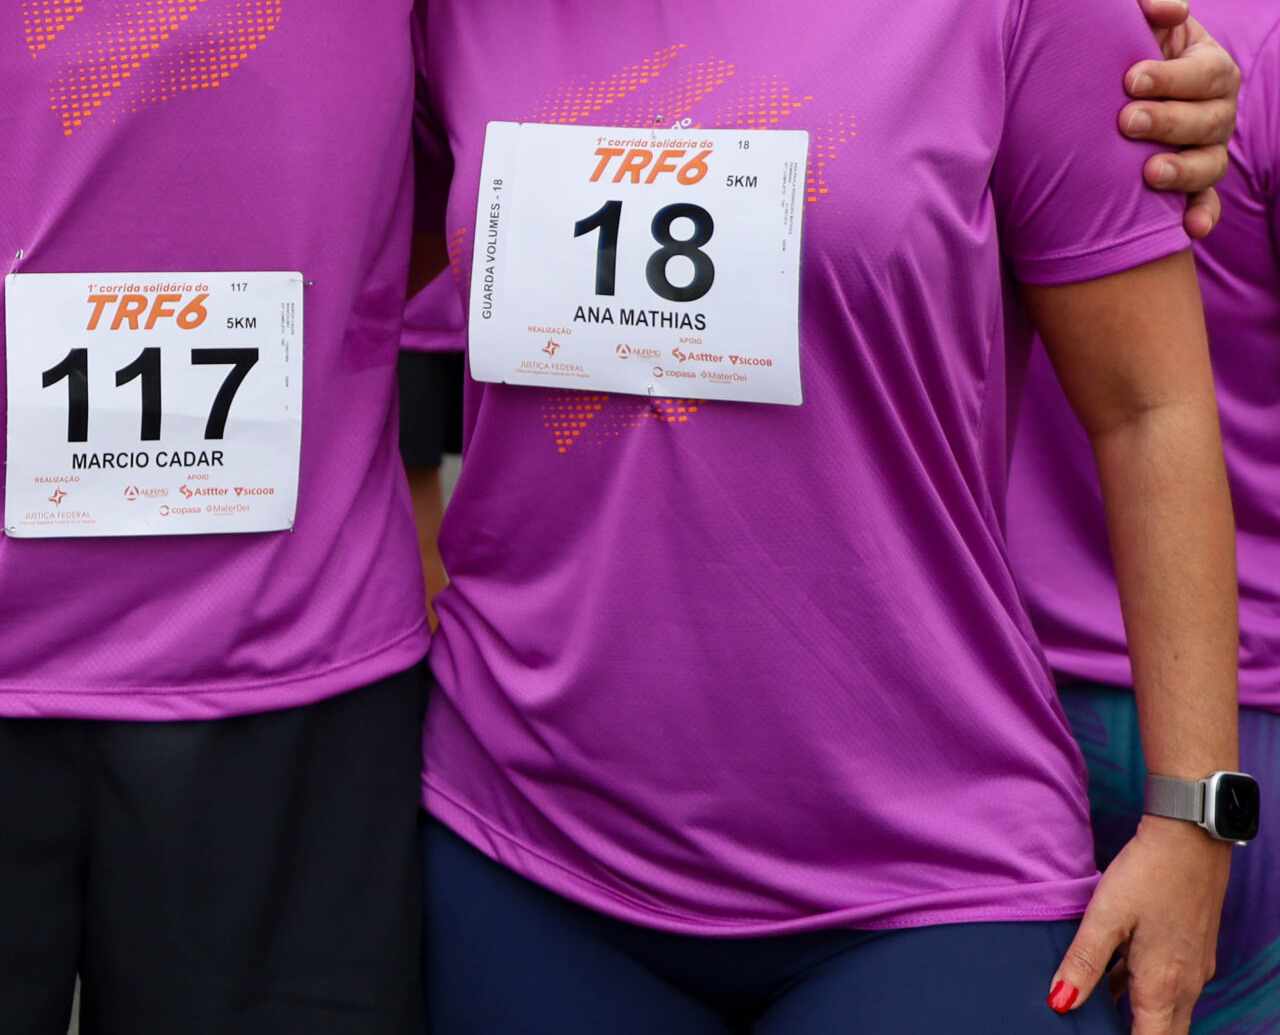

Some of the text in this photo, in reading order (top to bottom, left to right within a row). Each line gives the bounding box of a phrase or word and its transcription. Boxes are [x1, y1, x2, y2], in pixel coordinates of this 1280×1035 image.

[608, 138, 648, 148] corrida
[650, 139, 697, 149] solidária
[699, 140, 713, 149] do
[737, 140, 750, 150] 18
[589, 148, 714, 186] TRF6
[493, 179, 503, 191] 18
[726, 175, 758, 188] 5KM
[486, 203, 500, 263] VOLUMES
[573, 200, 715, 302] 18
[100, 284, 140, 293] corrida
[143, 283, 192, 293] solidária
[195, 283, 209, 292] do
[230, 283, 248, 292] 117
[482, 266, 495, 319] GUARDA
[86, 293, 210, 331] TRF6
[573, 305, 707, 331] ANA MATHIAS
[226, 317, 257, 329] 5KM
[679, 337, 702, 345] APOIO
[687, 351, 723, 363] Asttter
[739, 357, 772, 367] SICOOB
[665, 369, 696, 379] copasa
[42, 347, 259, 442] 117
[72, 450, 224, 469] MARCIO CADAR
[194, 487, 229, 496] Asttter
[243, 487, 275, 496] SICOOB
[171, 507, 201, 515] copasa
